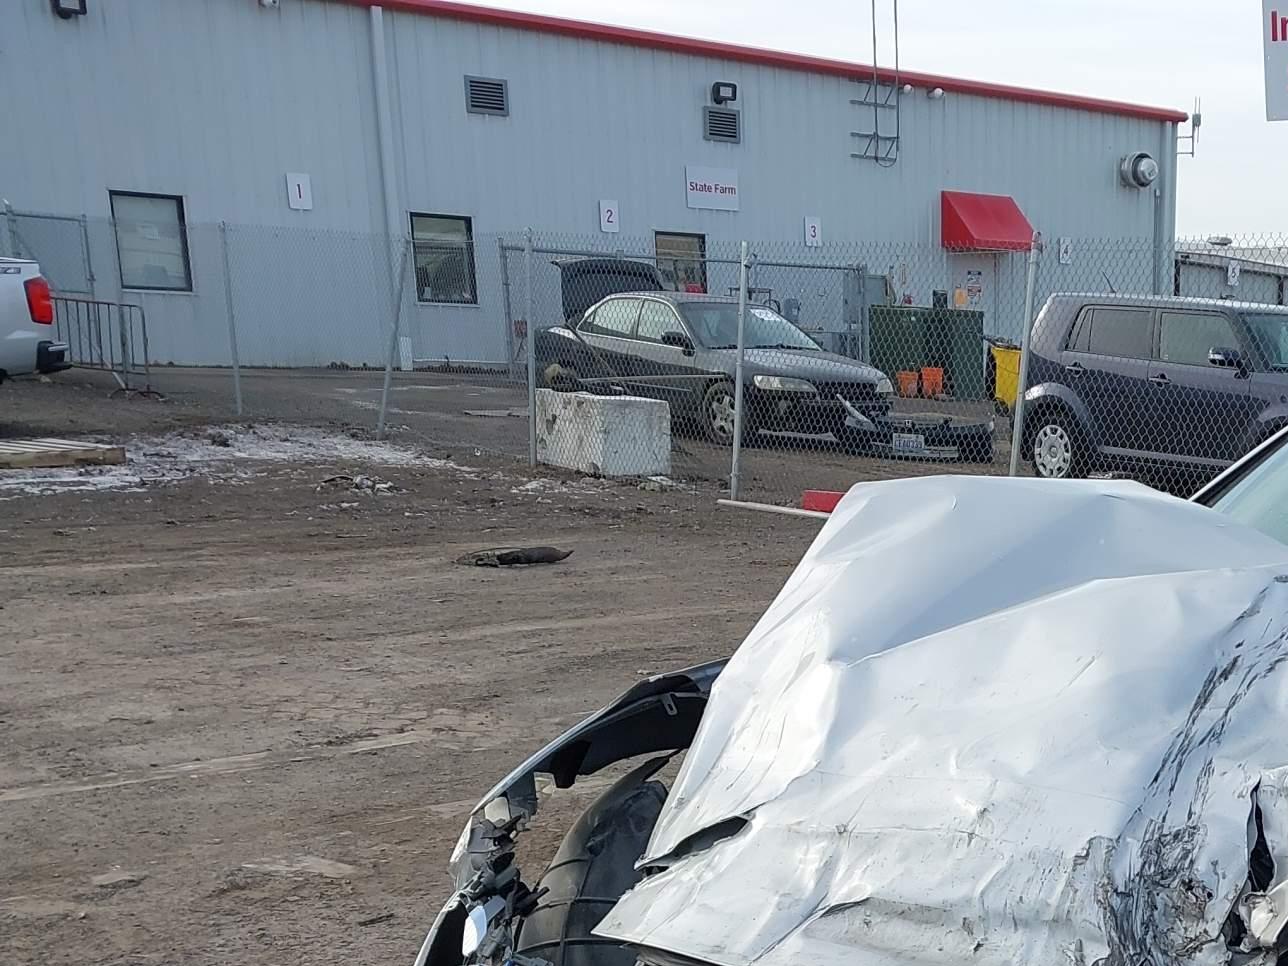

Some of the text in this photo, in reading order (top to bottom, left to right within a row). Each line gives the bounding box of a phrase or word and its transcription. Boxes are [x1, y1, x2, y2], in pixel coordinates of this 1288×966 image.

[689, 181, 737, 195] State Farm
[606, 209, 614, 224] 2
[810, 225, 817, 238] 3
